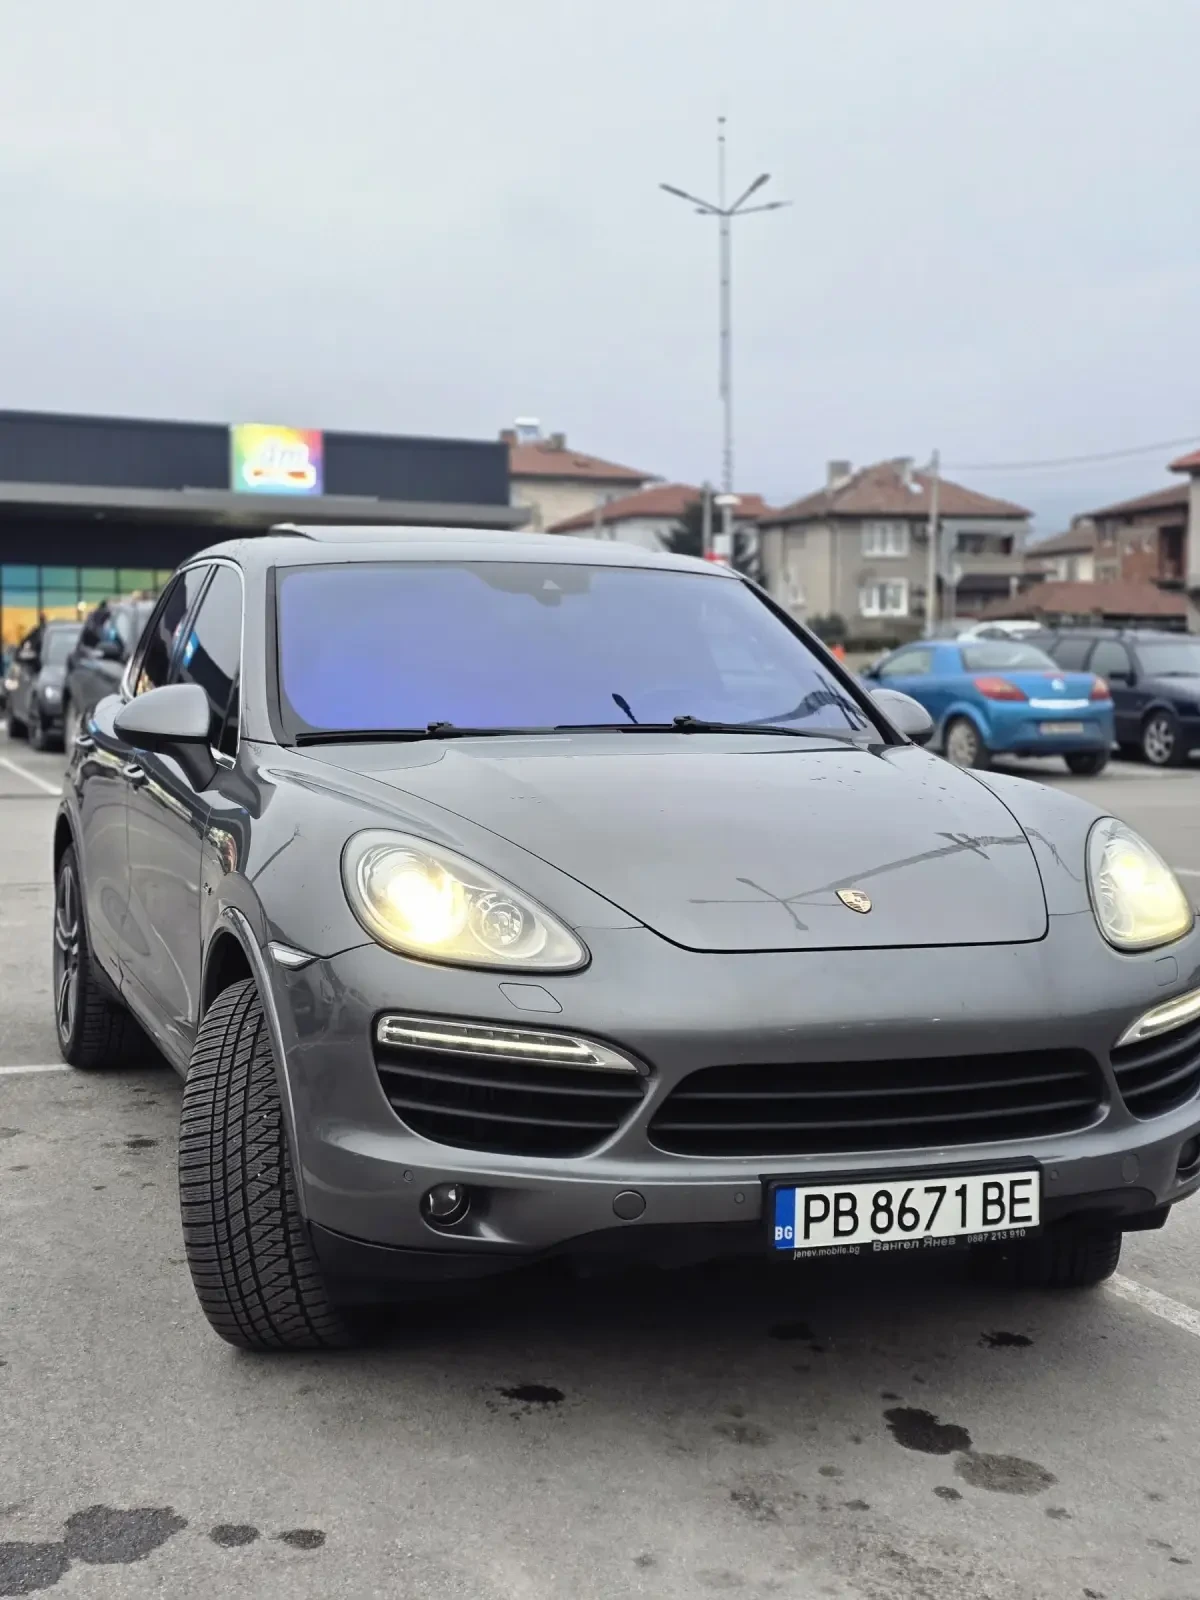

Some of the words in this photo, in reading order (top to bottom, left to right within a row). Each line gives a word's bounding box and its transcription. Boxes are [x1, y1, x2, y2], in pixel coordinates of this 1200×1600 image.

[803, 1193, 859, 1240] PB
[870, 1184, 968, 1235] 8671
[982, 1179, 1033, 1226] BE
[774, 1226, 793, 1241] BG
[991, 1231, 1007, 1241] 213
[872, 1241, 920, 1252] Вангел
[923, 1237, 956, 1248] Янев
